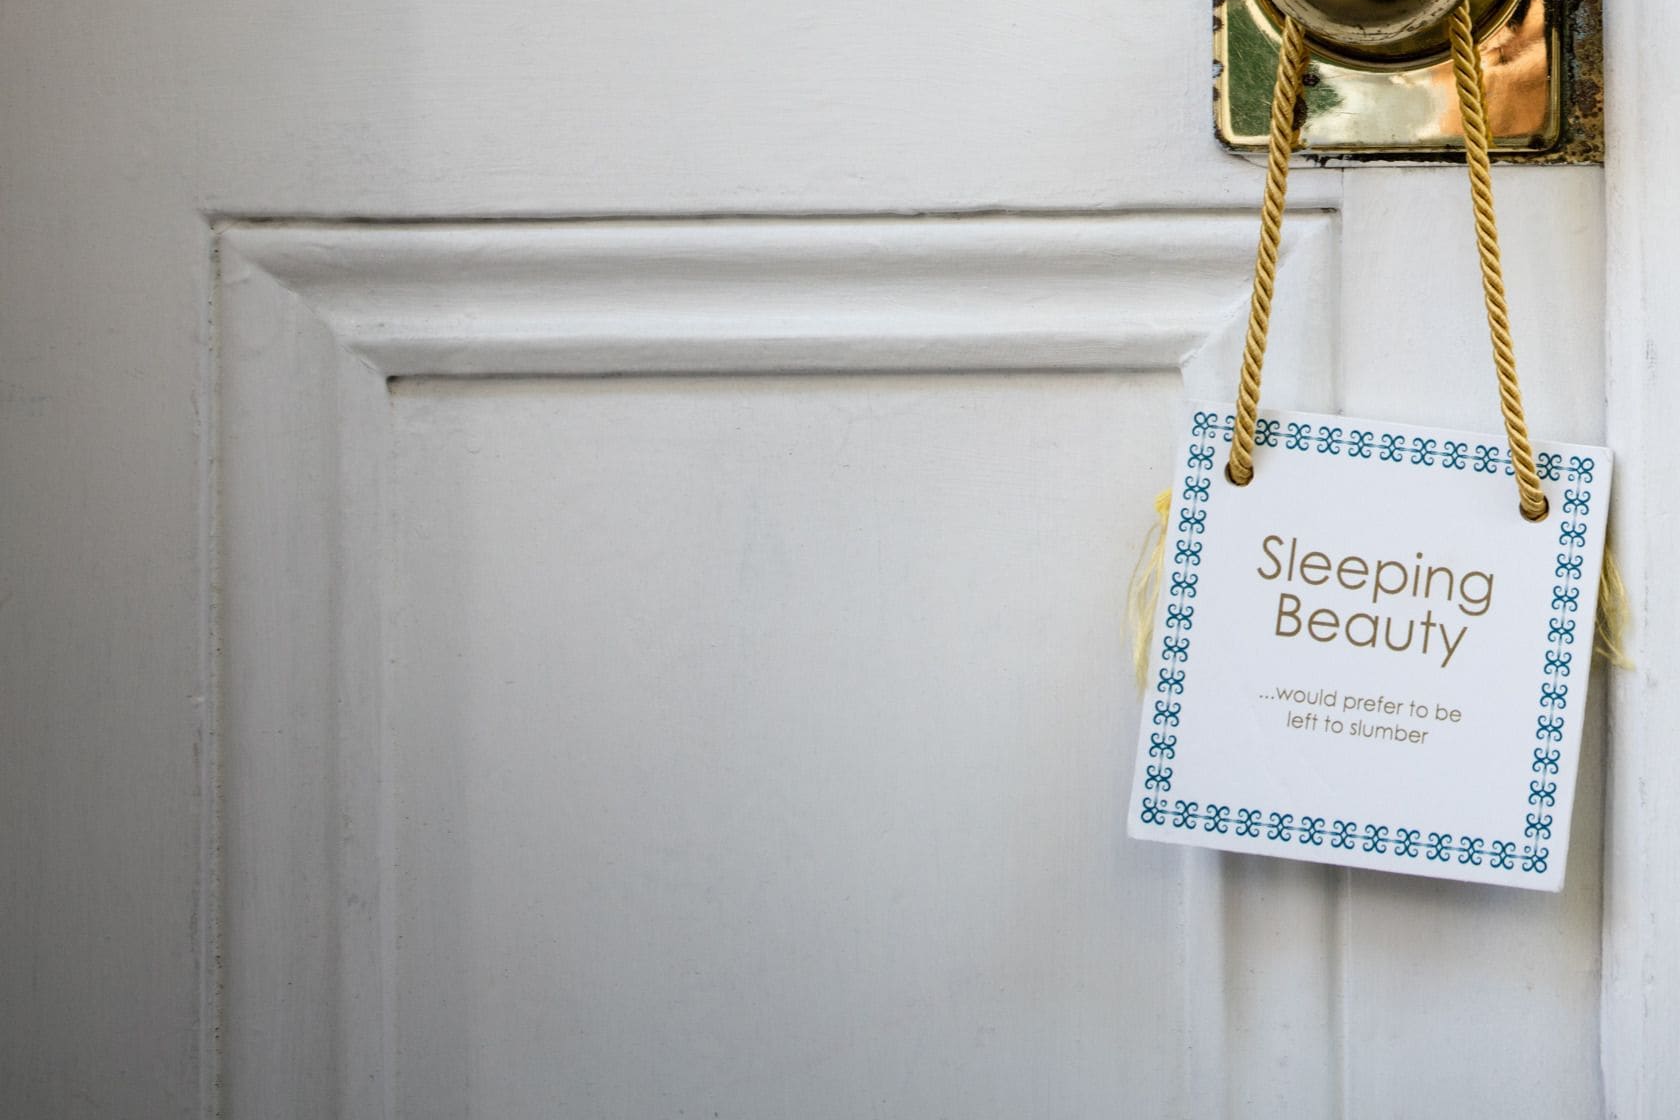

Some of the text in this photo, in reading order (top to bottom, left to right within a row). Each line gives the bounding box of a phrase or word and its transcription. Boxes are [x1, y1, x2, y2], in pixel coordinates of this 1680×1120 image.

[1256, 534, 1495, 617] Sleeping
[1274, 592, 1469, 669] Beauty
[1258, 686, 1463, 723] ...would prefer to be
[1286, 711, 1429, 745] left to slumber
